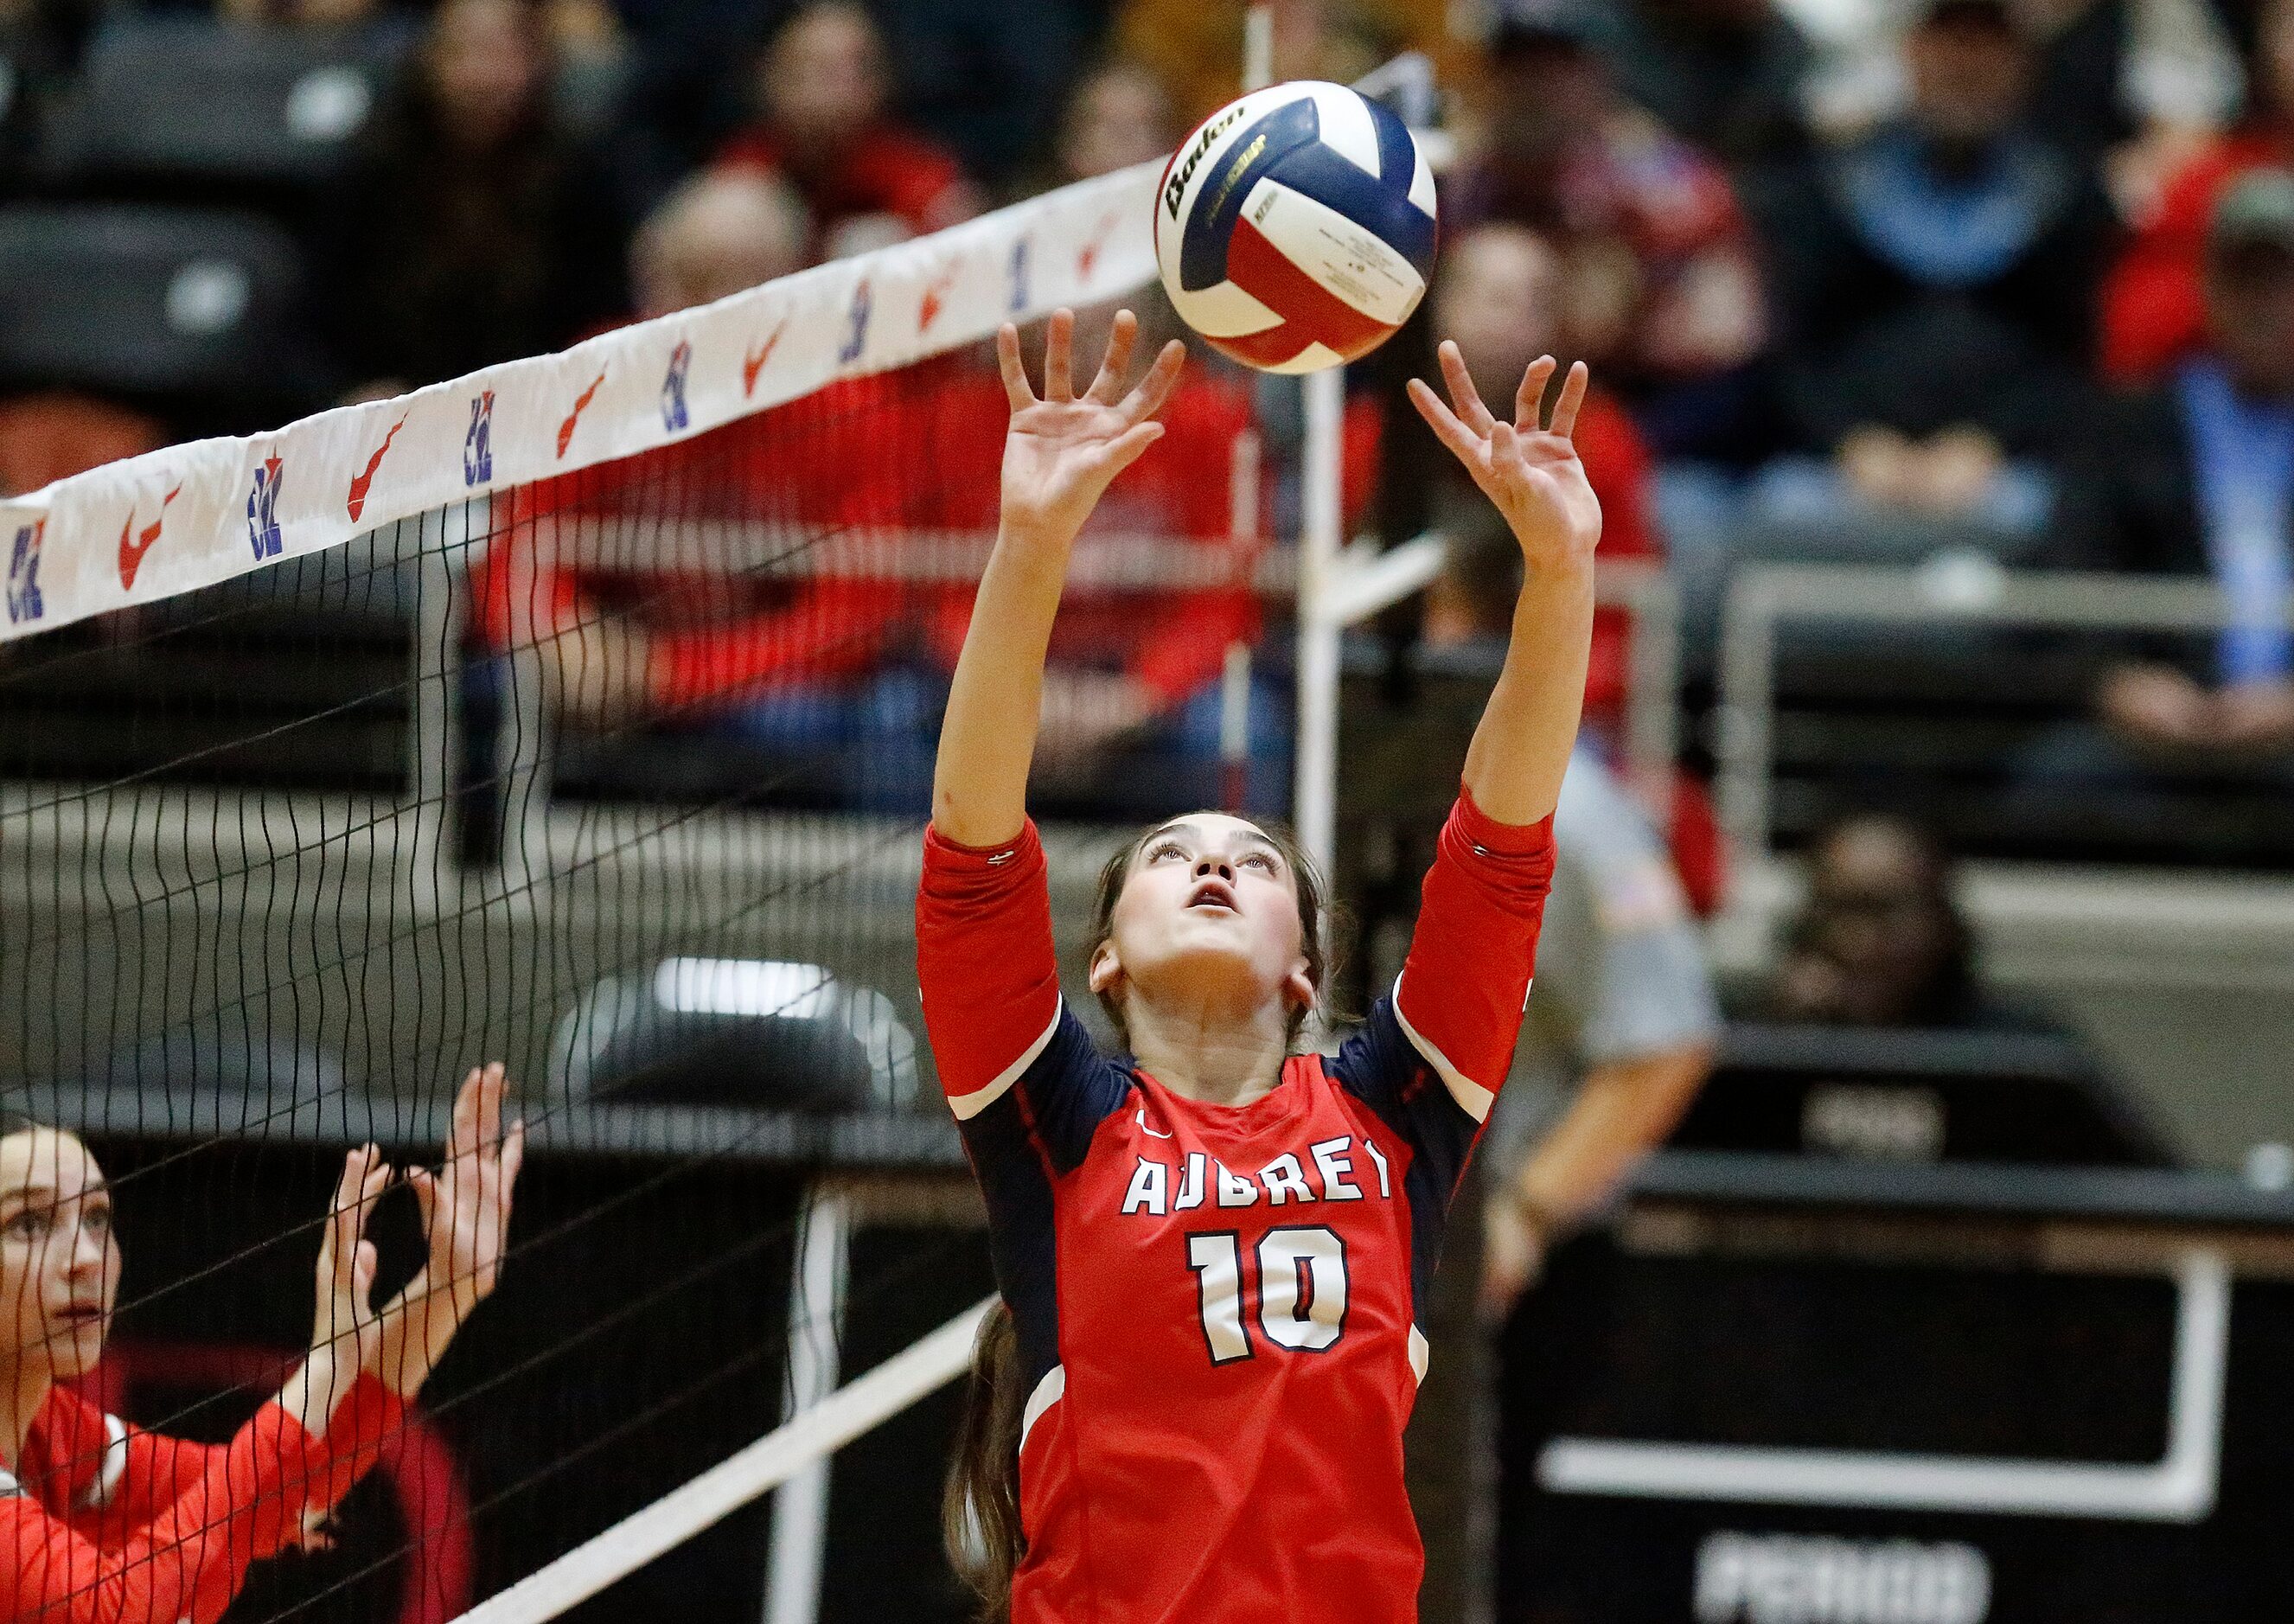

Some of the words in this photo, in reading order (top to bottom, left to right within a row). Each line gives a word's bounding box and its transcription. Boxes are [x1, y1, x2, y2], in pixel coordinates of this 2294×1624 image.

[1166, 106, 1245, 221] Baden
[1121, 1135, 1391, 1216] AUBREY
[1184, 1224, 1351, 1367] 10
